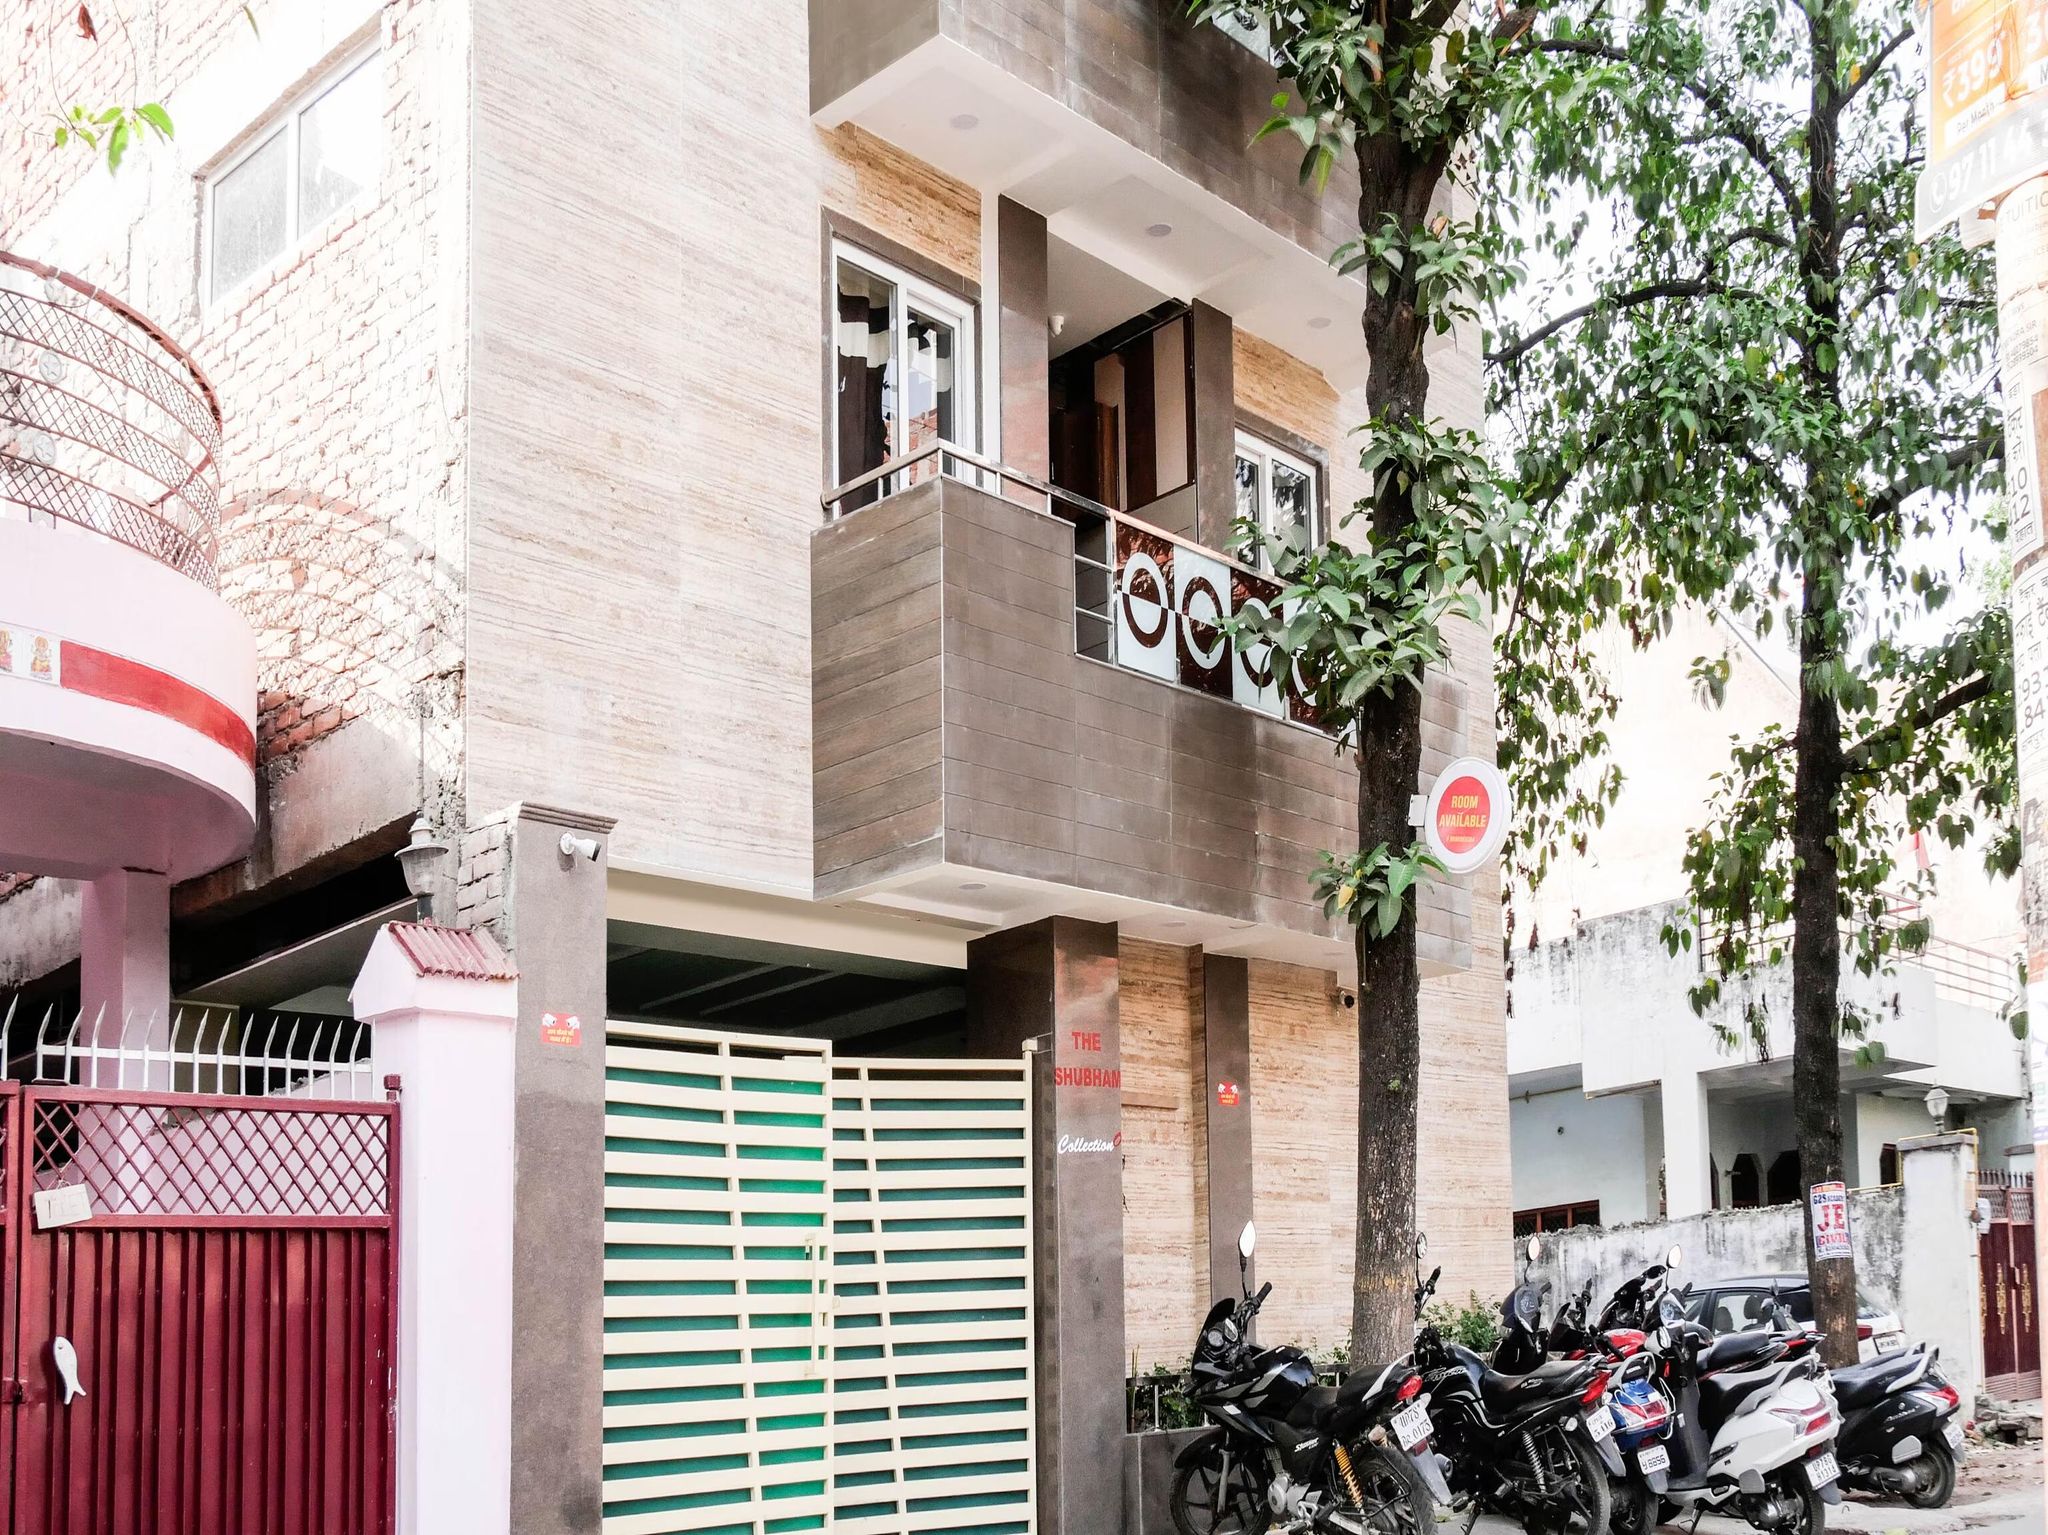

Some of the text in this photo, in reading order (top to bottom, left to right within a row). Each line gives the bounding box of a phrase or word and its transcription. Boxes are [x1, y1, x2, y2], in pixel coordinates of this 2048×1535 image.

[1451, 795, 1478, 809] ROOM
[1440, 814, 1487, 828] AVAILABLE
[1072, 1031, 1102, 1051] THE
[1054, 1067, 1121, 1088] SHUBHAM
[1058, 1134, 1114, 1154] Collection
[1817, 1203, 1845, 1232] JE
